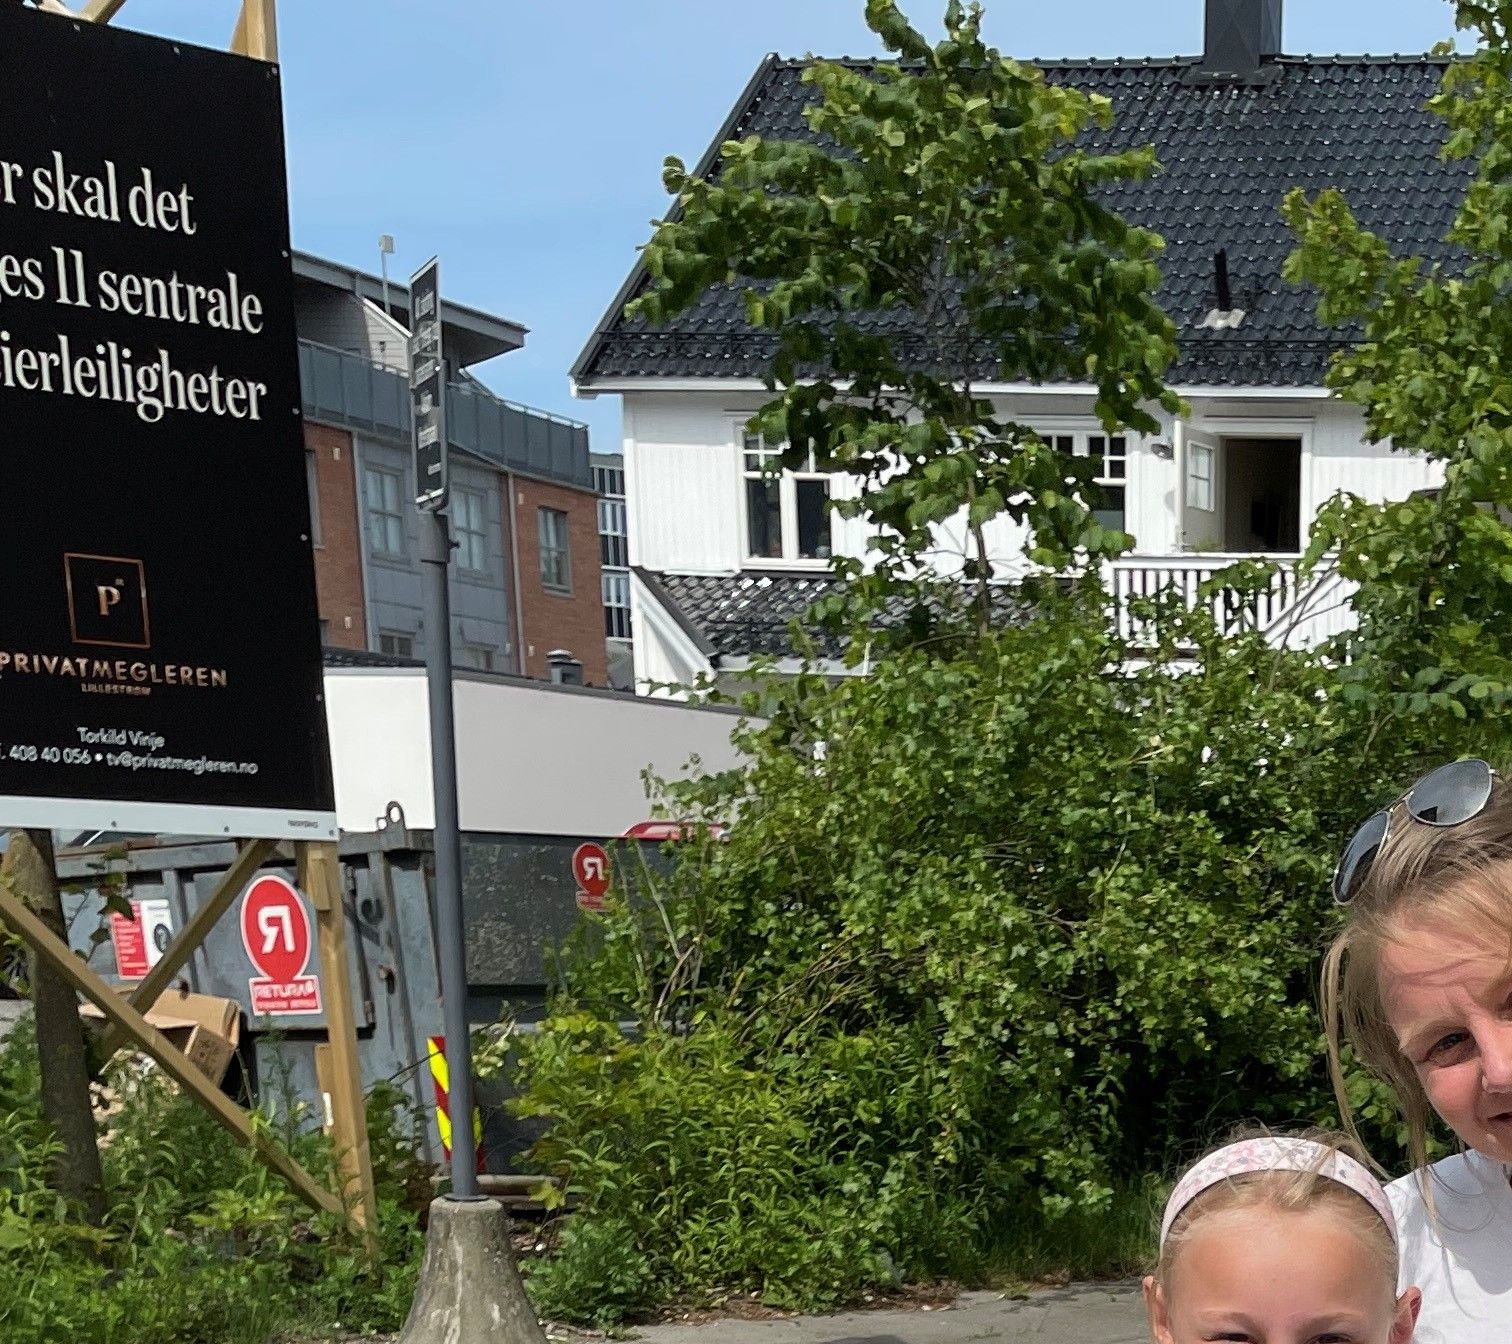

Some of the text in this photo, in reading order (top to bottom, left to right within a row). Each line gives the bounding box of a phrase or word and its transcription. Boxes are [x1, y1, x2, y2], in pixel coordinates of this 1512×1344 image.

[33, 150, 120, 223] skal
[129, 167, 197, 235] det
[98, 269, 264, 335] sentrale
[0, 652, 228, 687] PRIVATMEGLEREN
[41, 747, 60, 763] 40
